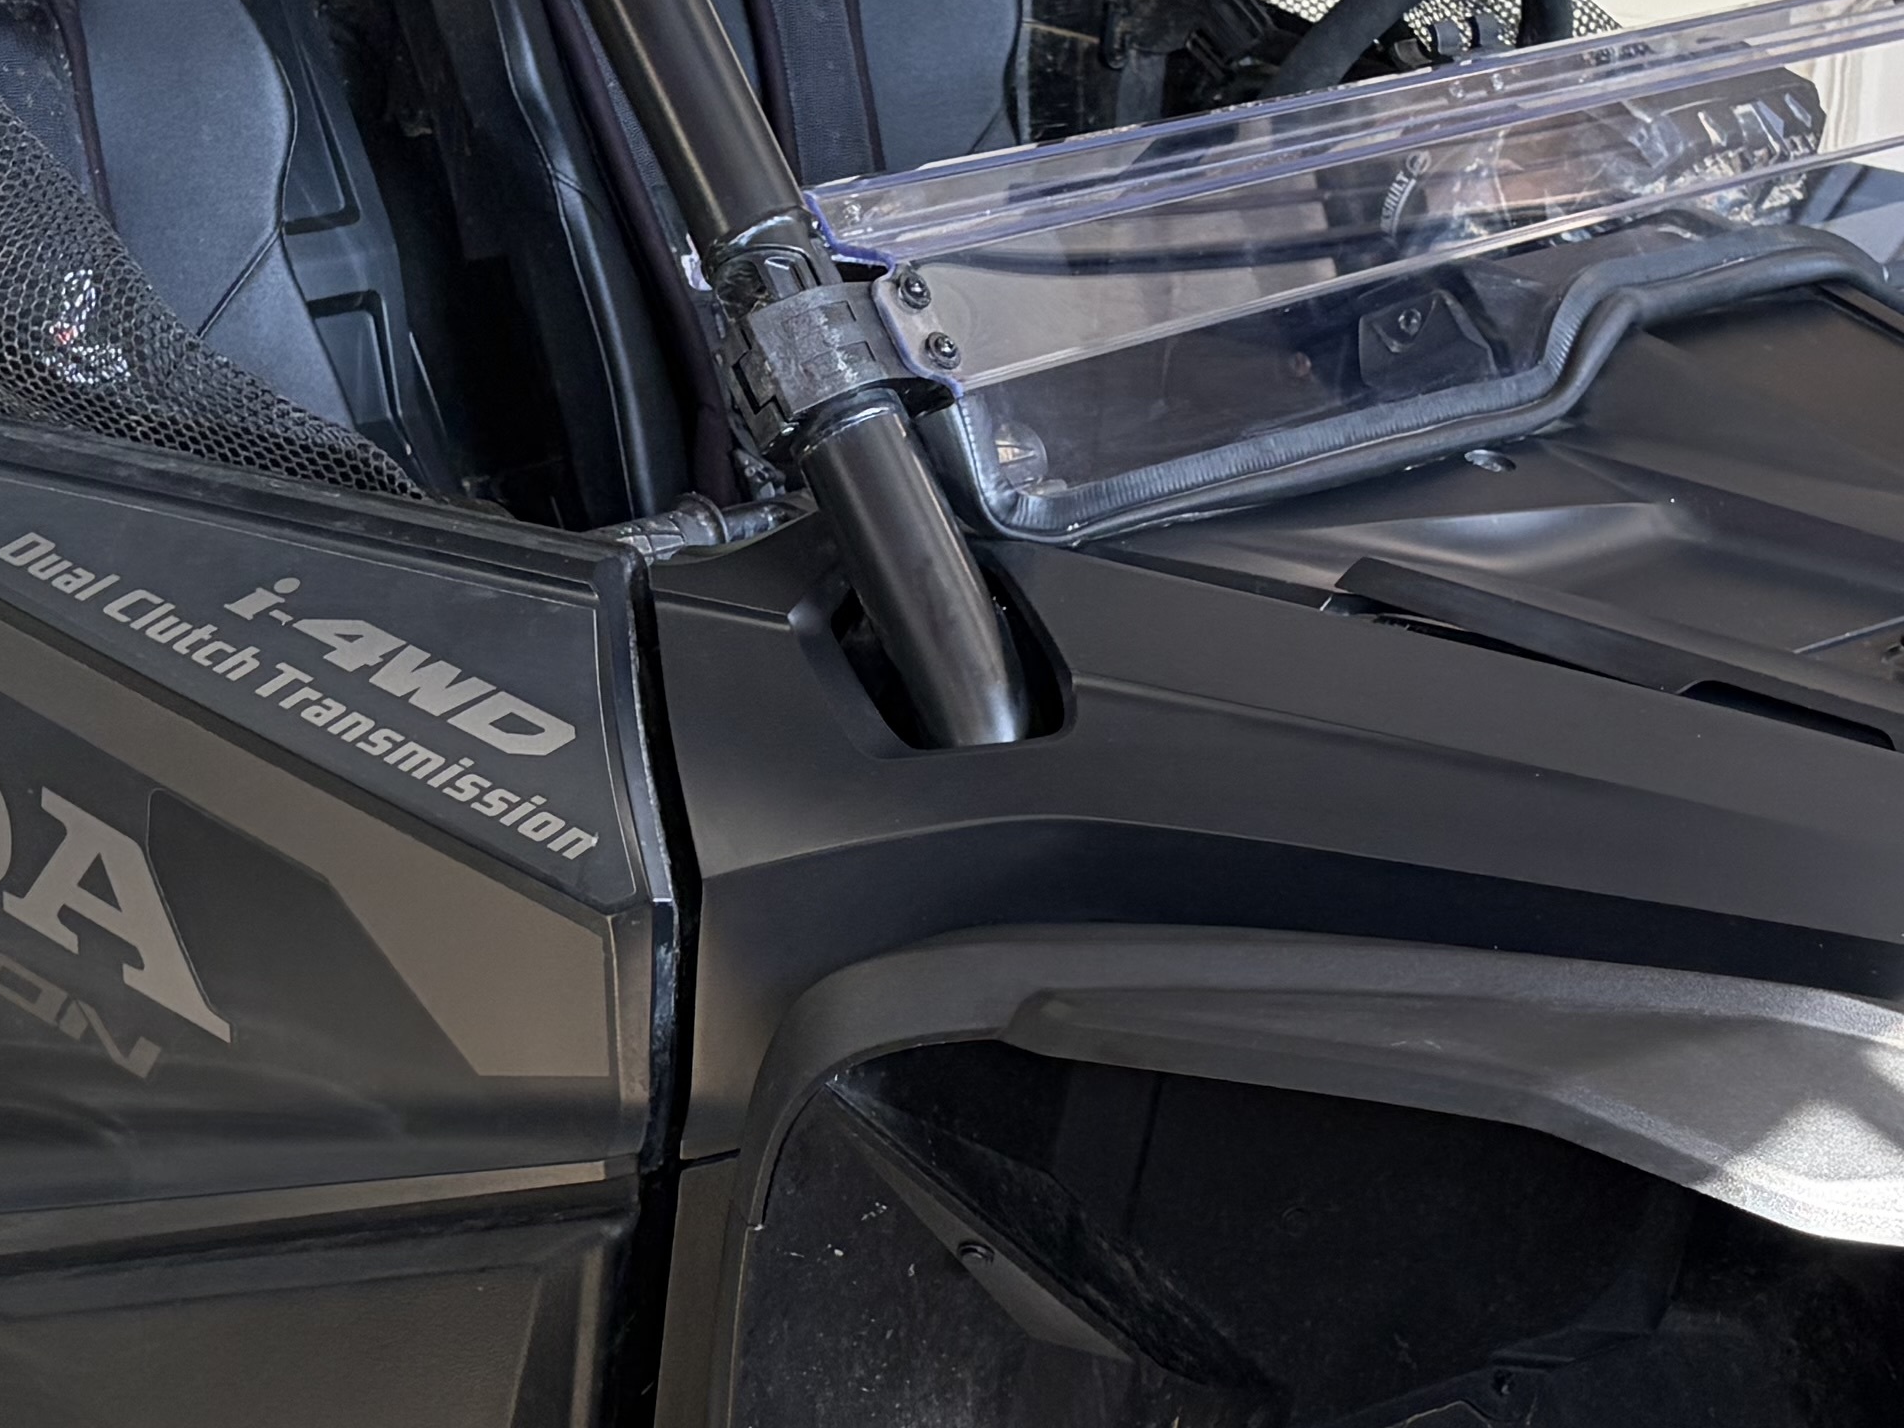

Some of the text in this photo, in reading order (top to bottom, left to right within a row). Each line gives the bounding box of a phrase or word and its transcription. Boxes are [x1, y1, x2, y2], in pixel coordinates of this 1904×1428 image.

[103, 588, 263, 683] Clutch
[254, 660, 600, 861] Transmission
[223, 576, 577, 757] i-4WD
